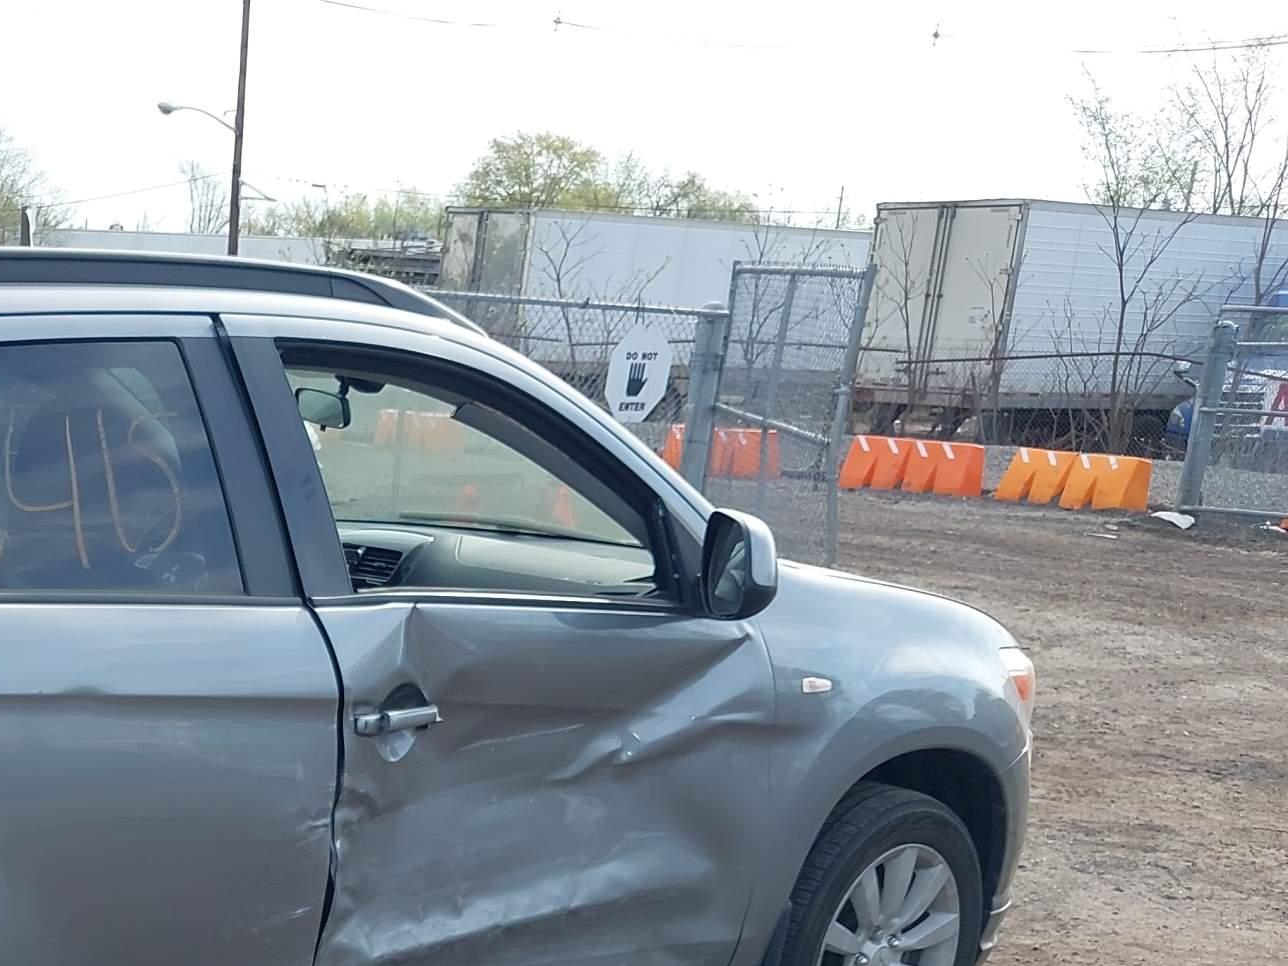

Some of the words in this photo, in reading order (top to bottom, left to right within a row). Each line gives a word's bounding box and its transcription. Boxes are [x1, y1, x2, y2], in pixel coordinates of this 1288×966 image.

[626, 352, 638, 361] DO
[641, 352, 658, 361] NOT
[618, 402, 645, 412] ENTER
